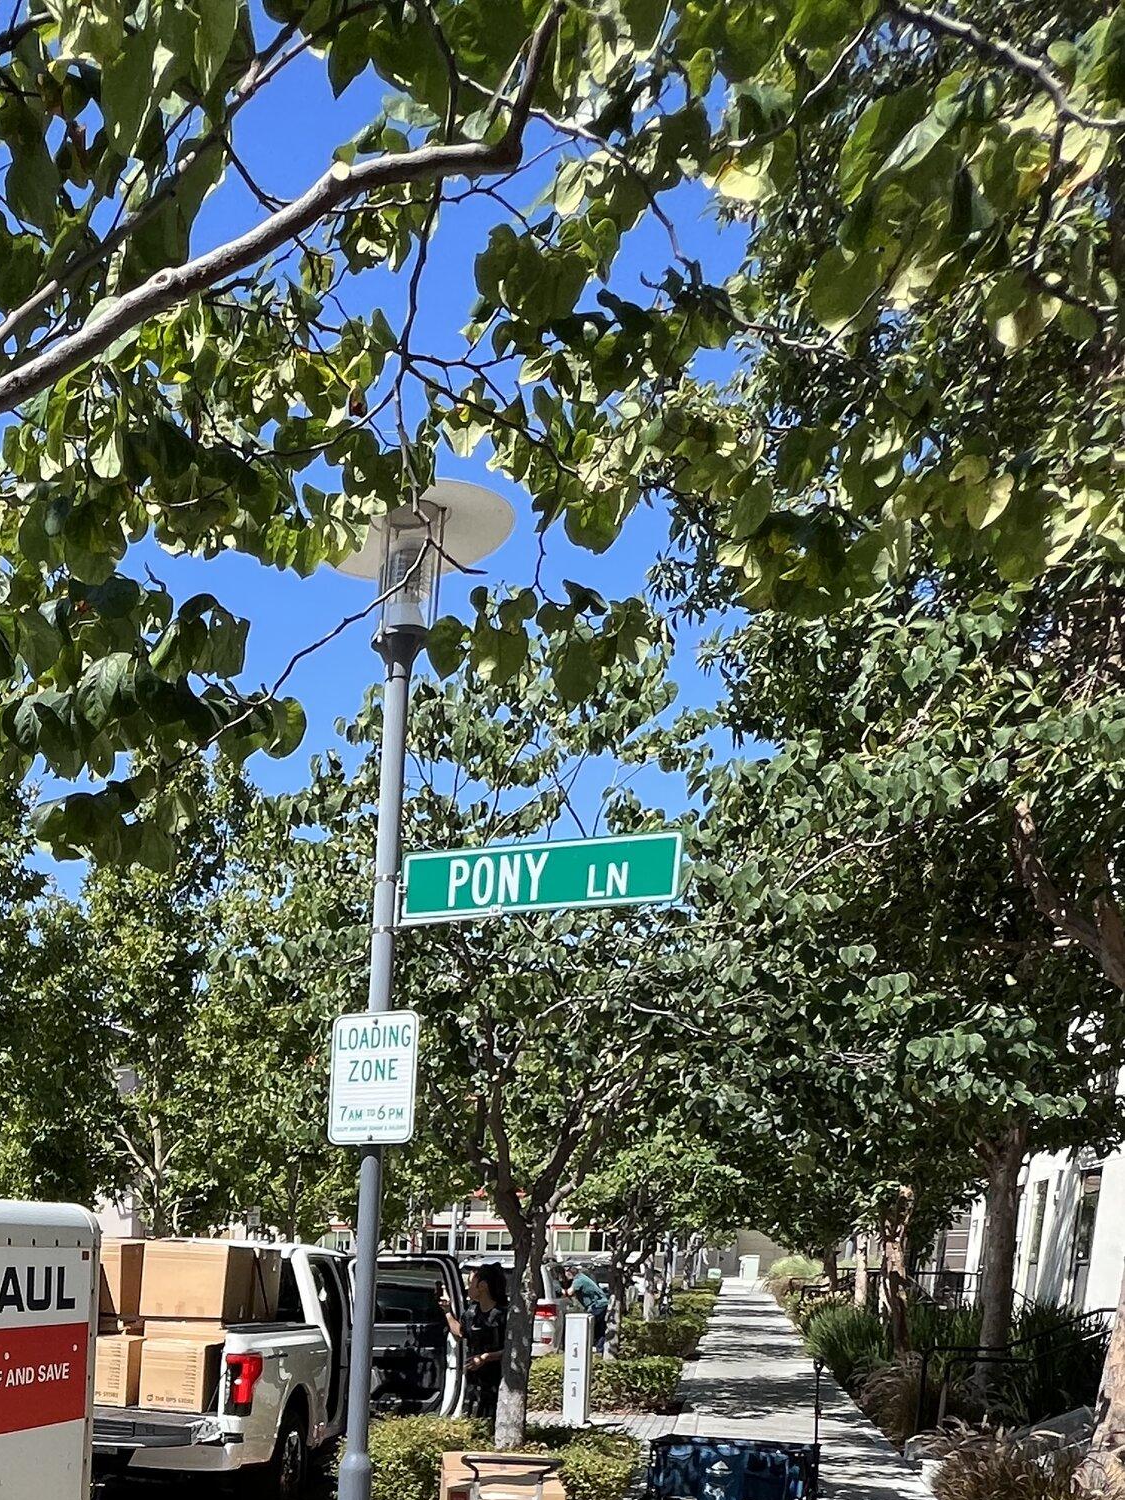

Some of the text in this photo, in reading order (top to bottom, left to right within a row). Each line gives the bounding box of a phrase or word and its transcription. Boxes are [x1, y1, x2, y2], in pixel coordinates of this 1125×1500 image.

[448, 852, 629, 908] PONY LN
[338, 1024, 412, 1051] LOADING
[348, 1058, 399, 1082] ZONE
[5, 1366, 35, 1388] AND
[37, 1362, 70, 1383] SAVE
